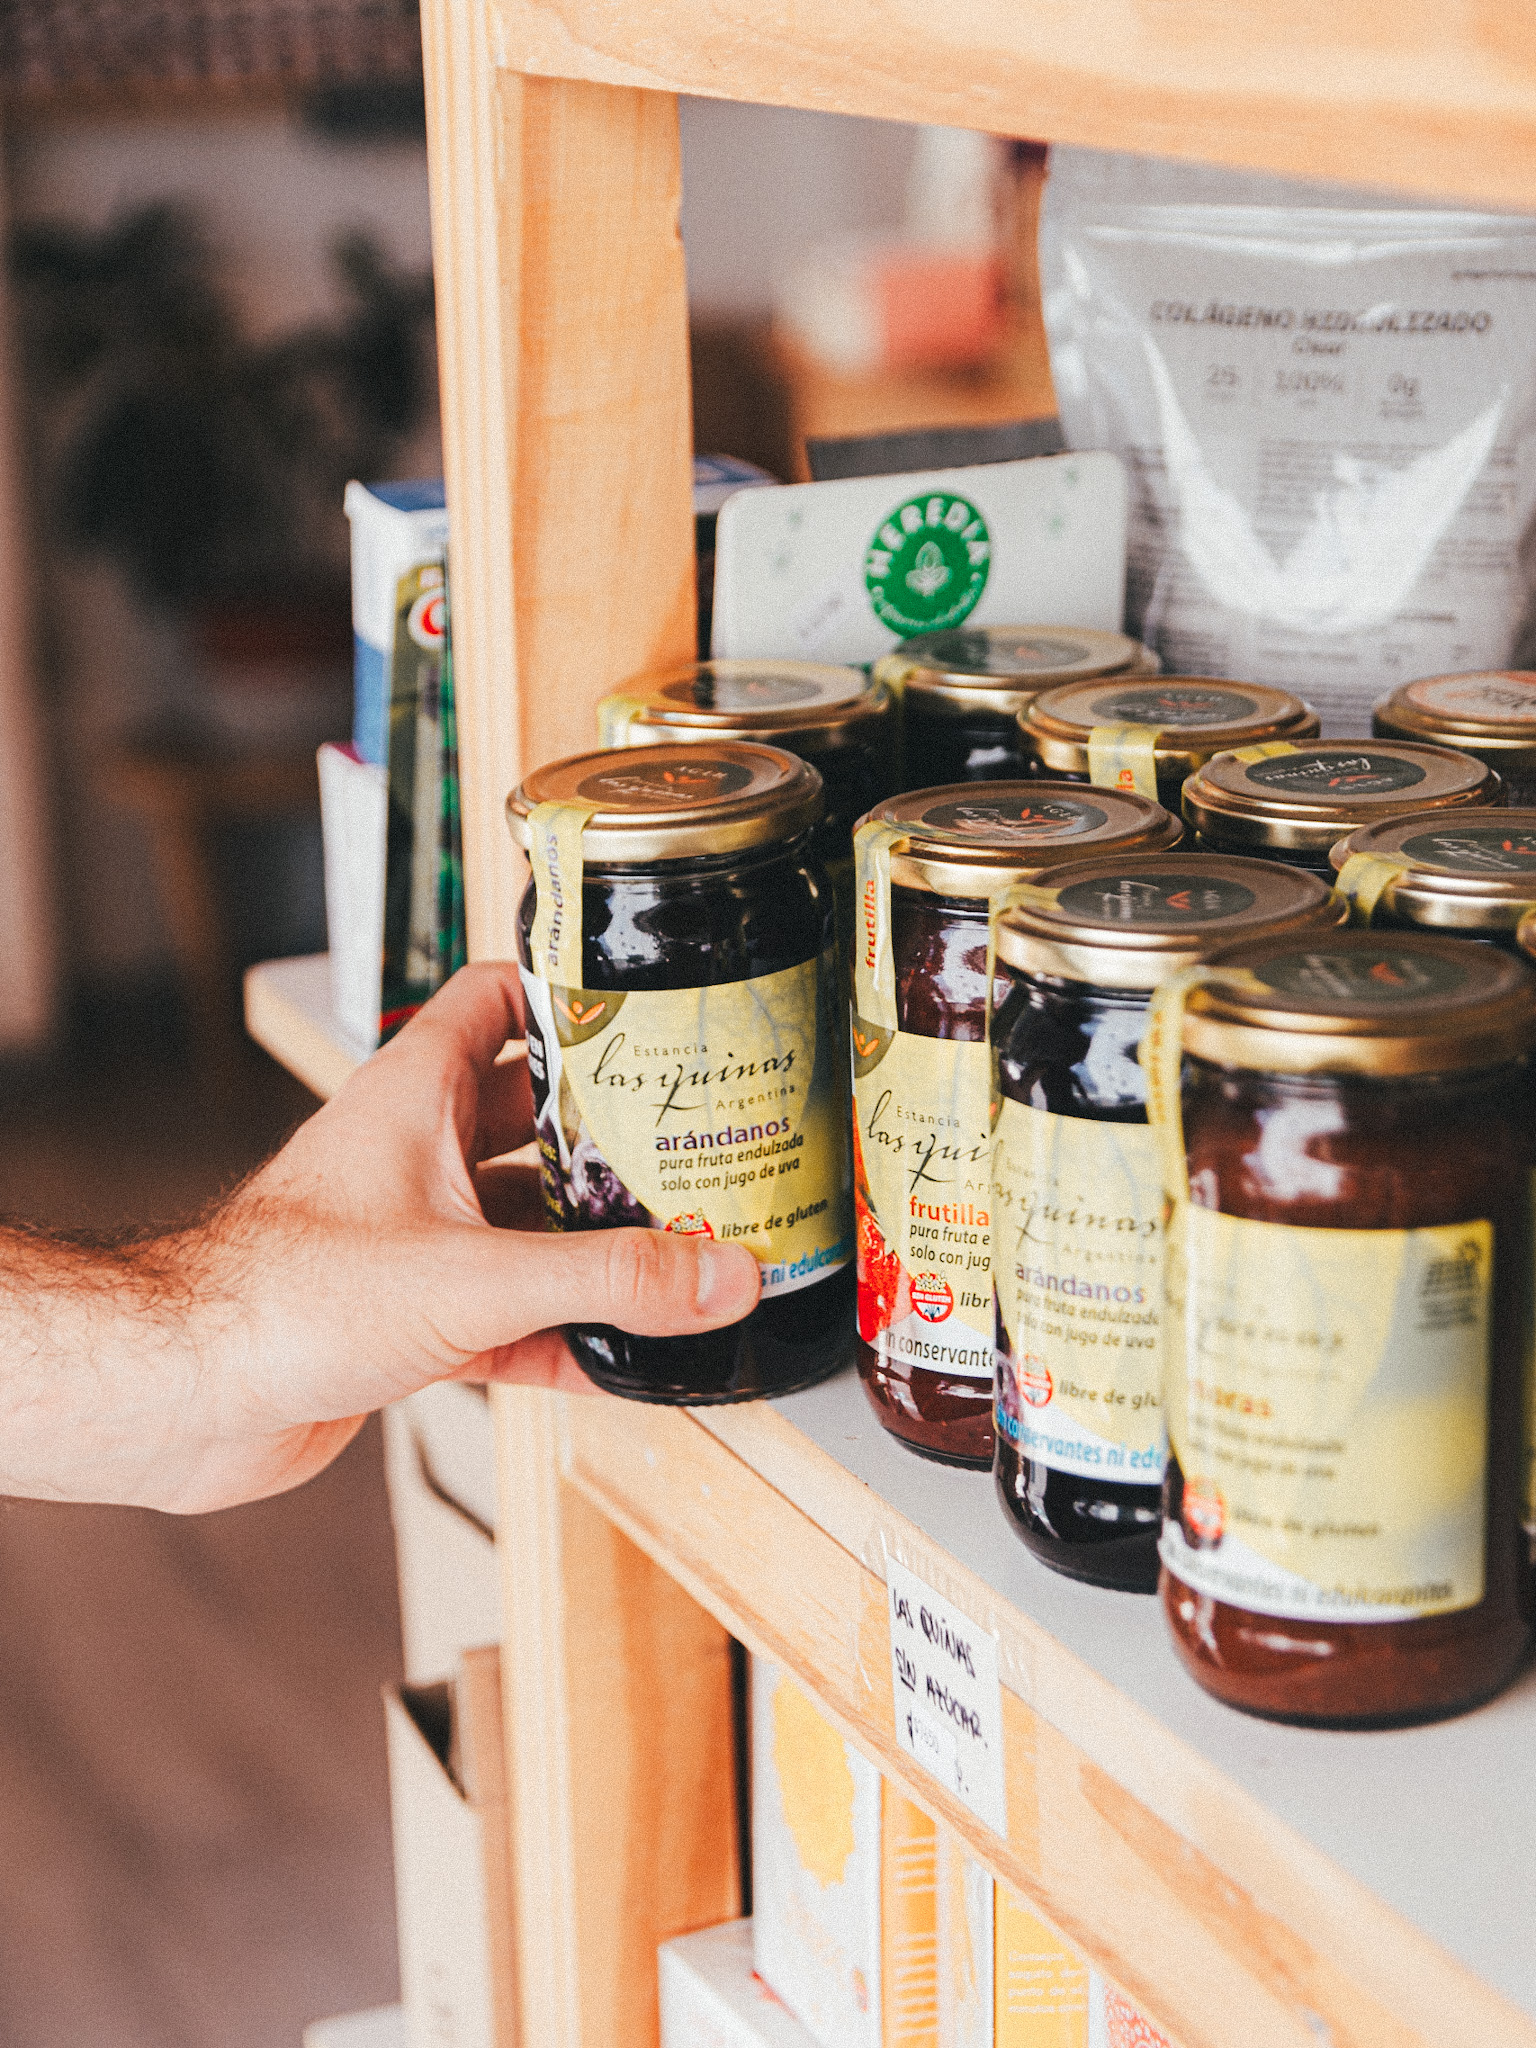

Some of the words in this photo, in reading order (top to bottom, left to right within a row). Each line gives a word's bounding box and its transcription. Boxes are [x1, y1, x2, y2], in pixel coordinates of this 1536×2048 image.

[867, 497, 990, 580] HEREDIA
[864, 880, 877, 969] frutilla
[587, 1032, 649, 1092] las
[633, 1044, 708, 1057] Estancia
[715, 1084, 797, 1111] Argentina
[896, 1105, 961, 1128] Estancia
[656, 1116, 790, 1152] arándanos
[865, 1089, 905, 1153] las
[906, 1133, 991, 1194] qui
[658, 1154, 695, 1174] pura
[697, 1149, 733, 1169] fruta
[737, 1131, 804, 1163] endulzada
[660, 1176, 692, 1192] solo
[695, 1171, 721, 1190] con
[723, 1168, 756, 1191] jugo
[758, 1163, 775, 1180] de
[777, 1155, 801, 1176] uva
[720, 1222, 760, 1240] libre
[763, 1215, 783, 1231] de
[786, 1199, 829, 1228] gluten
[909, 1195, 990, 1227] frutilla
[909, 1224, 939, 1239] pura
[942, 1226, 978, 1245] fruta
[770, 1258, 787, 1285] ni
[909, 1245, 936, 1261] solo
[938, 1251, 963, 1266] con
[966, 1251, 991, 1272] jug
[1015, 1262, 1145, 1303] arándanos
[960, 1291, 991, 1309] libr
[1064, 1325, 1099, 1347] jugo
[1102, 1331, 1120, 1347] de
[1125, 1336, 1156, 1350] uva
[1059, 1380, 1100, 1401] libre
[1103, 1389, 1126, 1405] de
[1106, 1440, 1126, 1466] ni
[893, 1588, 914, 1629] LAS
